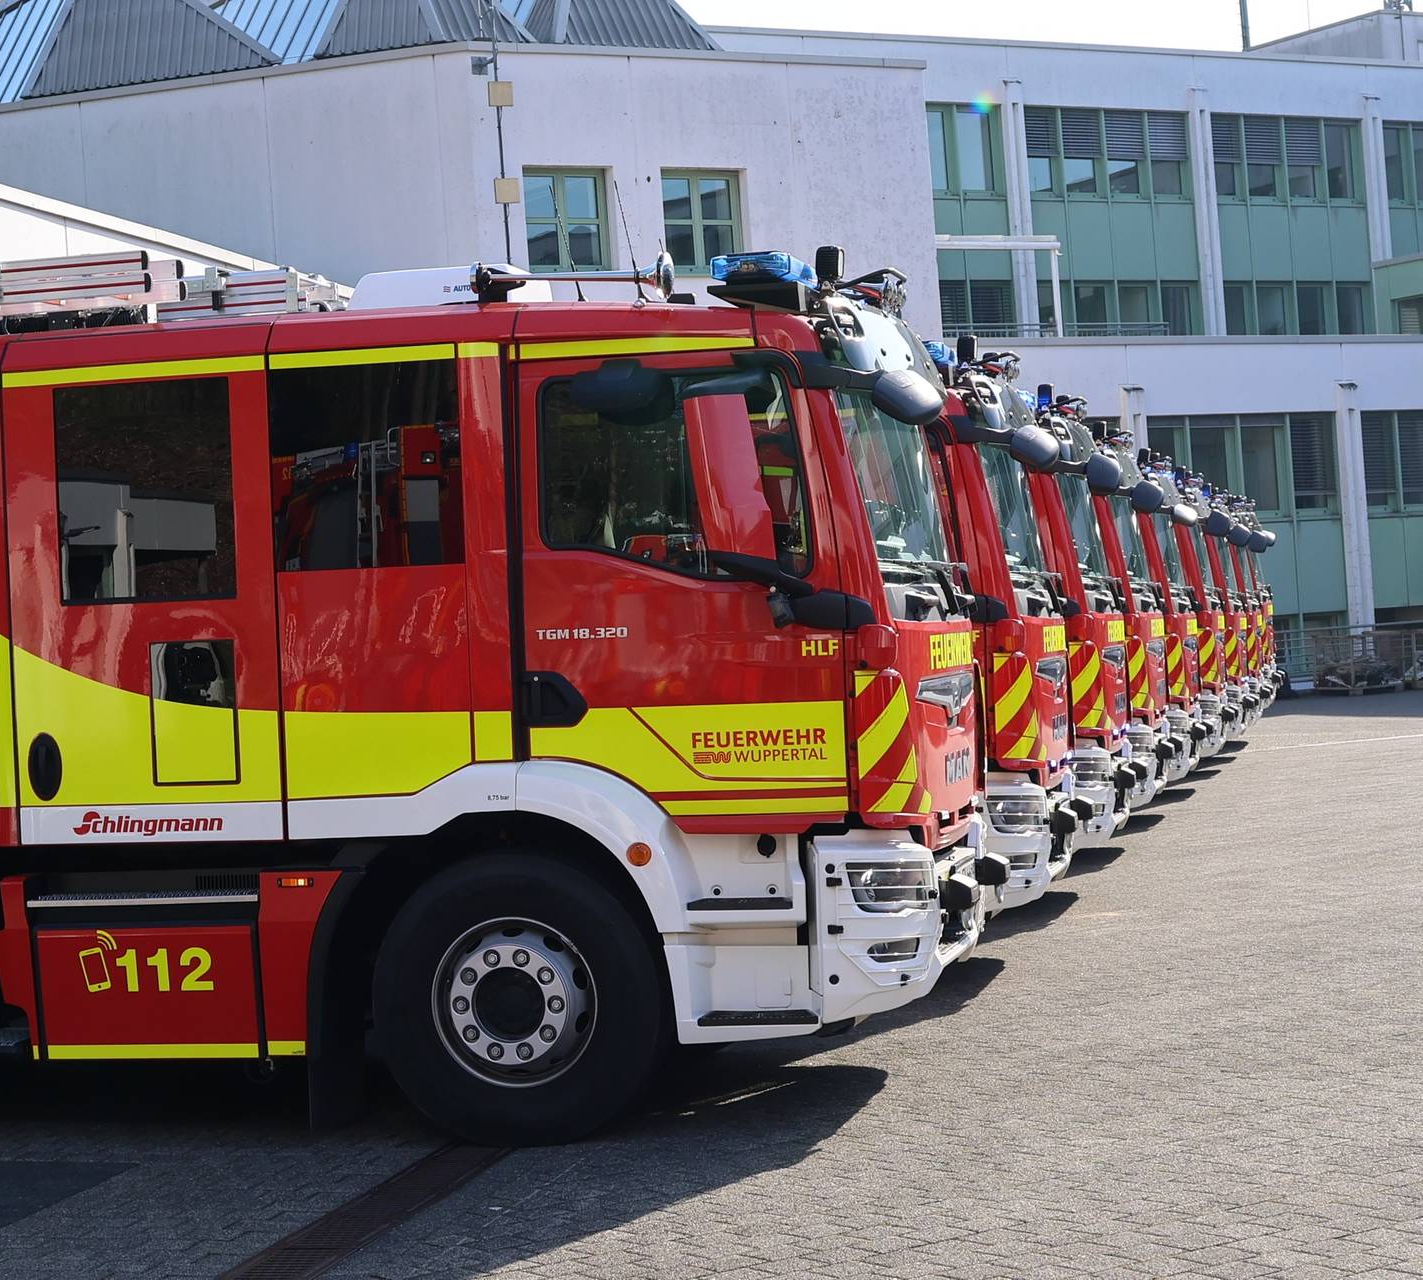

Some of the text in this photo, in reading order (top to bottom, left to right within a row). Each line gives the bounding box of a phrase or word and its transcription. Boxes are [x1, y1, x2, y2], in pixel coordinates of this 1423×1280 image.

[536, 627, 628, 640] TGM 18.320
[801, 639, 839, 657] HLF
[691, 728, 827, 748] FEUERWEHR
[734, 748, 827, 763] WUPPERTAL
[73, 811, 224, 836] Schlingmann
[115, 947, 214, 992] 112
